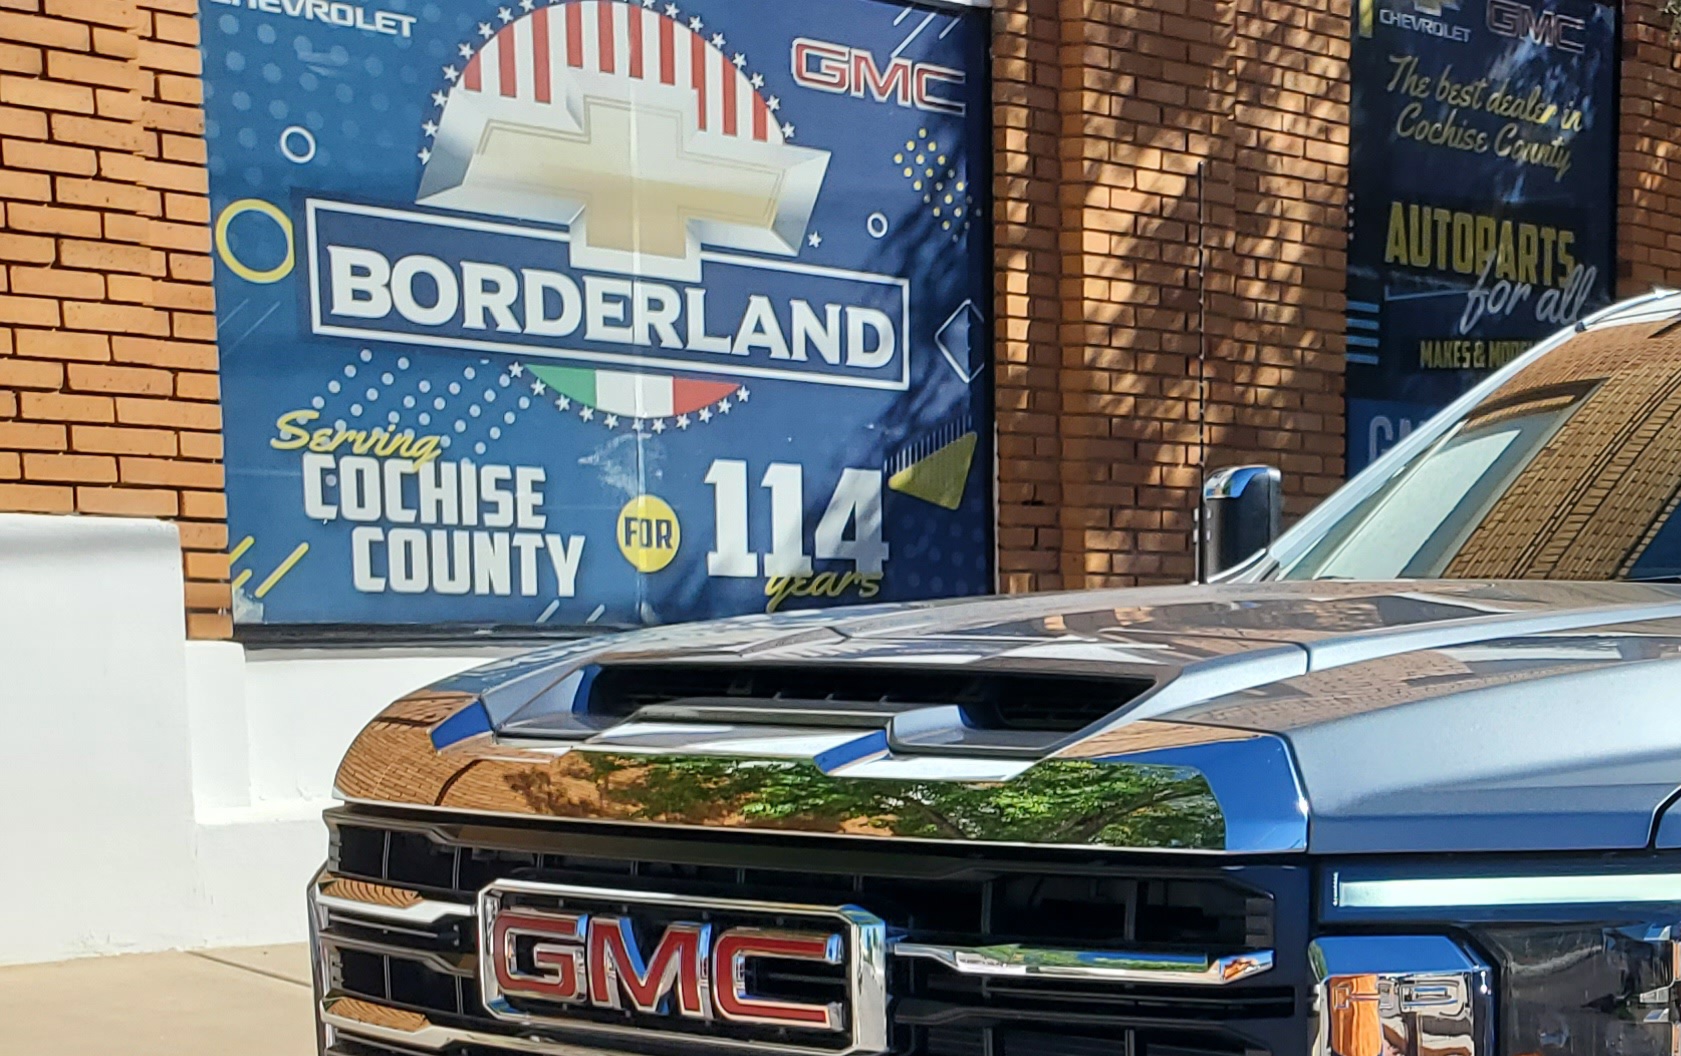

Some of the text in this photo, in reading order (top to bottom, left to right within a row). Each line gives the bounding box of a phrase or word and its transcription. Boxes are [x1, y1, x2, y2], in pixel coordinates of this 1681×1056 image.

[210, 0, 418, 38] EVROLET
[1379, 9, 1471, 42] CHEVROLET
[1487, 0, 1586, 54] GMC
[791, 37, 966, 115] GMC
[1387, 54, 1583, 132] The best dealer in
[1396, 103, 1571, 182] Cochise County
[1384, 201, 1575, 286] AUTOPARTS
[326, 244, 897, 369] BORDERLAND
[1459, 250, 1598, 335] for all
[1420, 340, 1471, 369] MAKES
[1473, 341, 1486, 368] &
[271, 409, 443, 472] Serving
[303, 453, 547, 529] COCHISE
[703, 458, 890, 579] 114
[352, 528, 586, 598] COUNTY
[624, 515, 673, 552] FOR
[763, 568, 880, 612] years
[494, 908, 846, 1033] GMC
